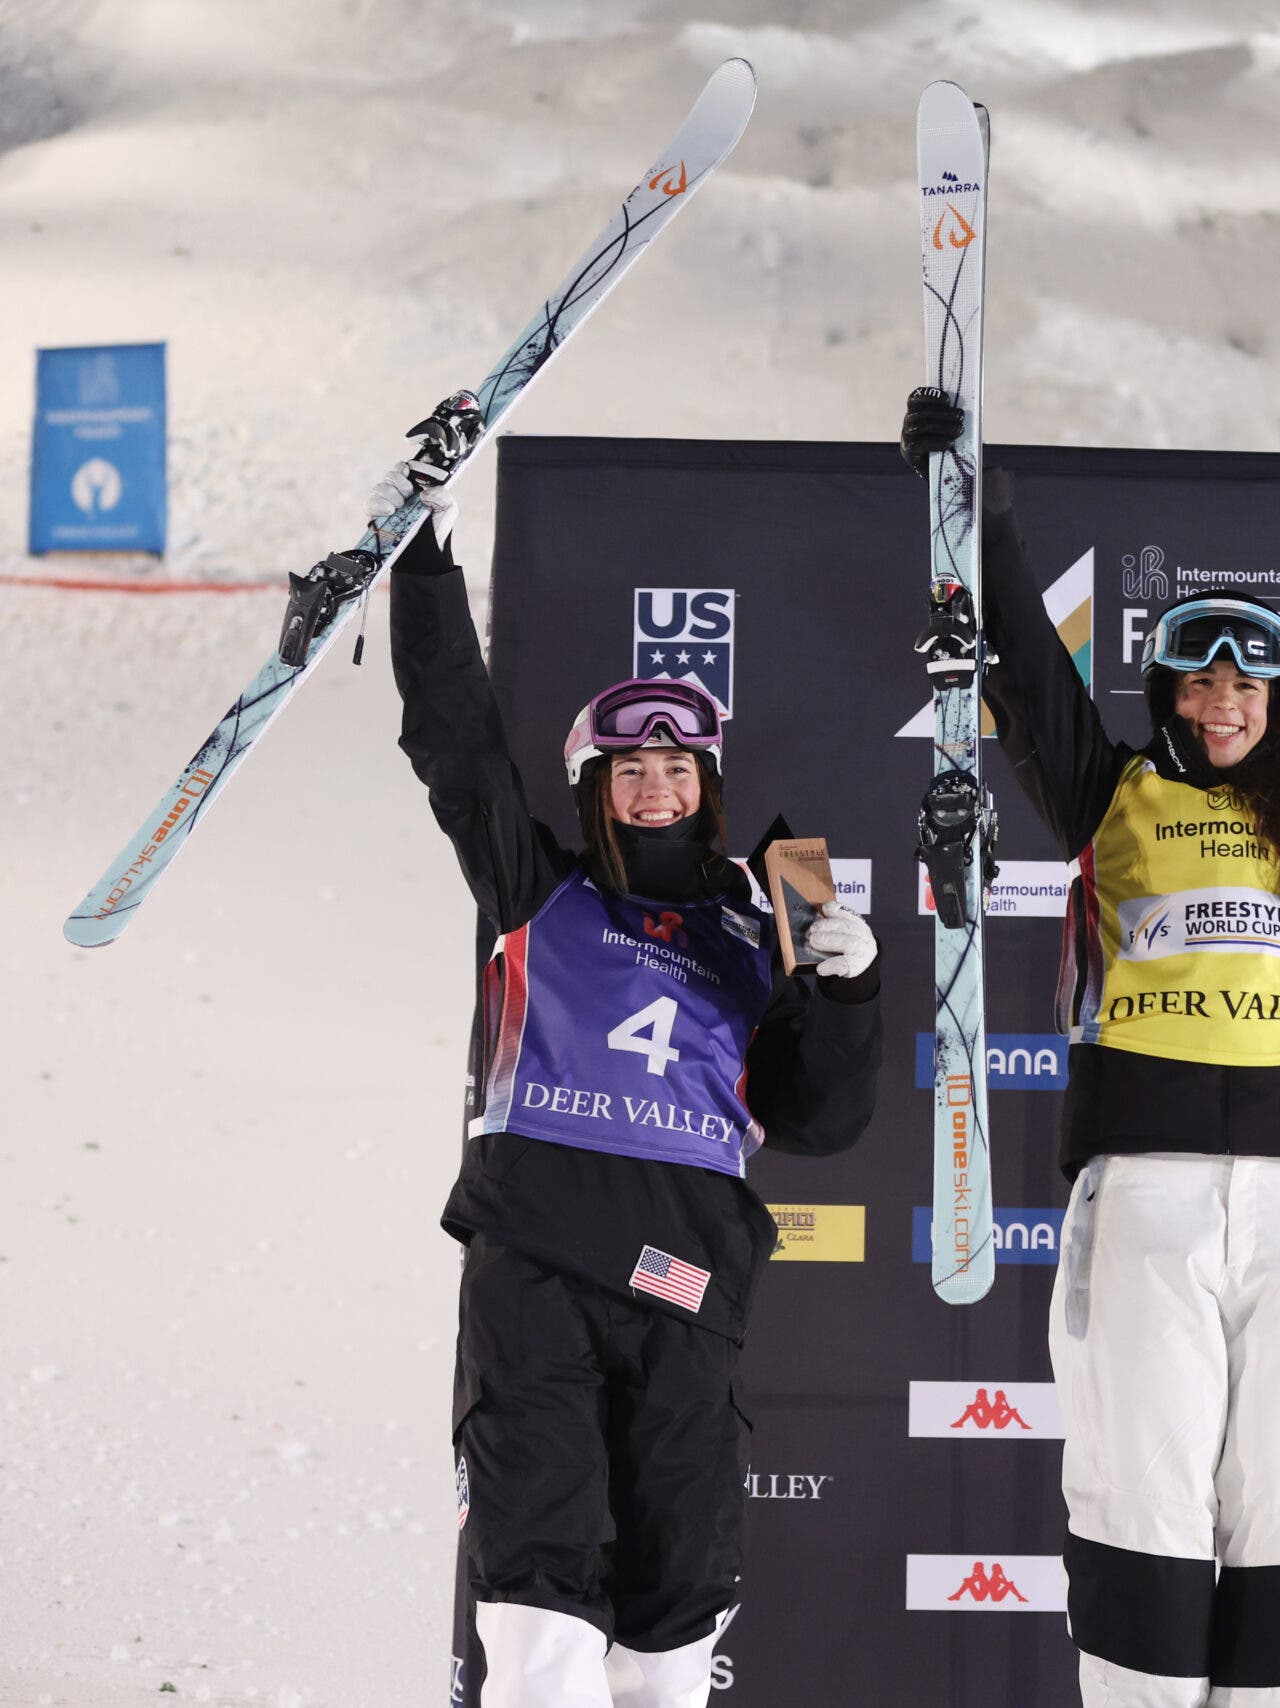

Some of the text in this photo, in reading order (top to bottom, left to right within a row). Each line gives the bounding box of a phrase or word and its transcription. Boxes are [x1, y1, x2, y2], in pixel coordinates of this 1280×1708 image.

[921, 183, 980, 197] TANARRA
[637, 591, 731, 640] US
[1155, 820, 1259, 842] Intermou
[1200, 839, 1270, 862] Health
[991, 883, 1070, 897] ermountai
[989, 900, 1017, 912] alth
[1185, 919, 1247, 937] WORLD
[602, 928, 721, 985] Intermountain
[635, 952, 688, 984] Health
[607, 996, 680, 1077] 4
[522, 1082, 613, 1121] DEER
[621, 1096, 736, 1144] VALLEY
[744, 1473, 828, 1500] LLEY
